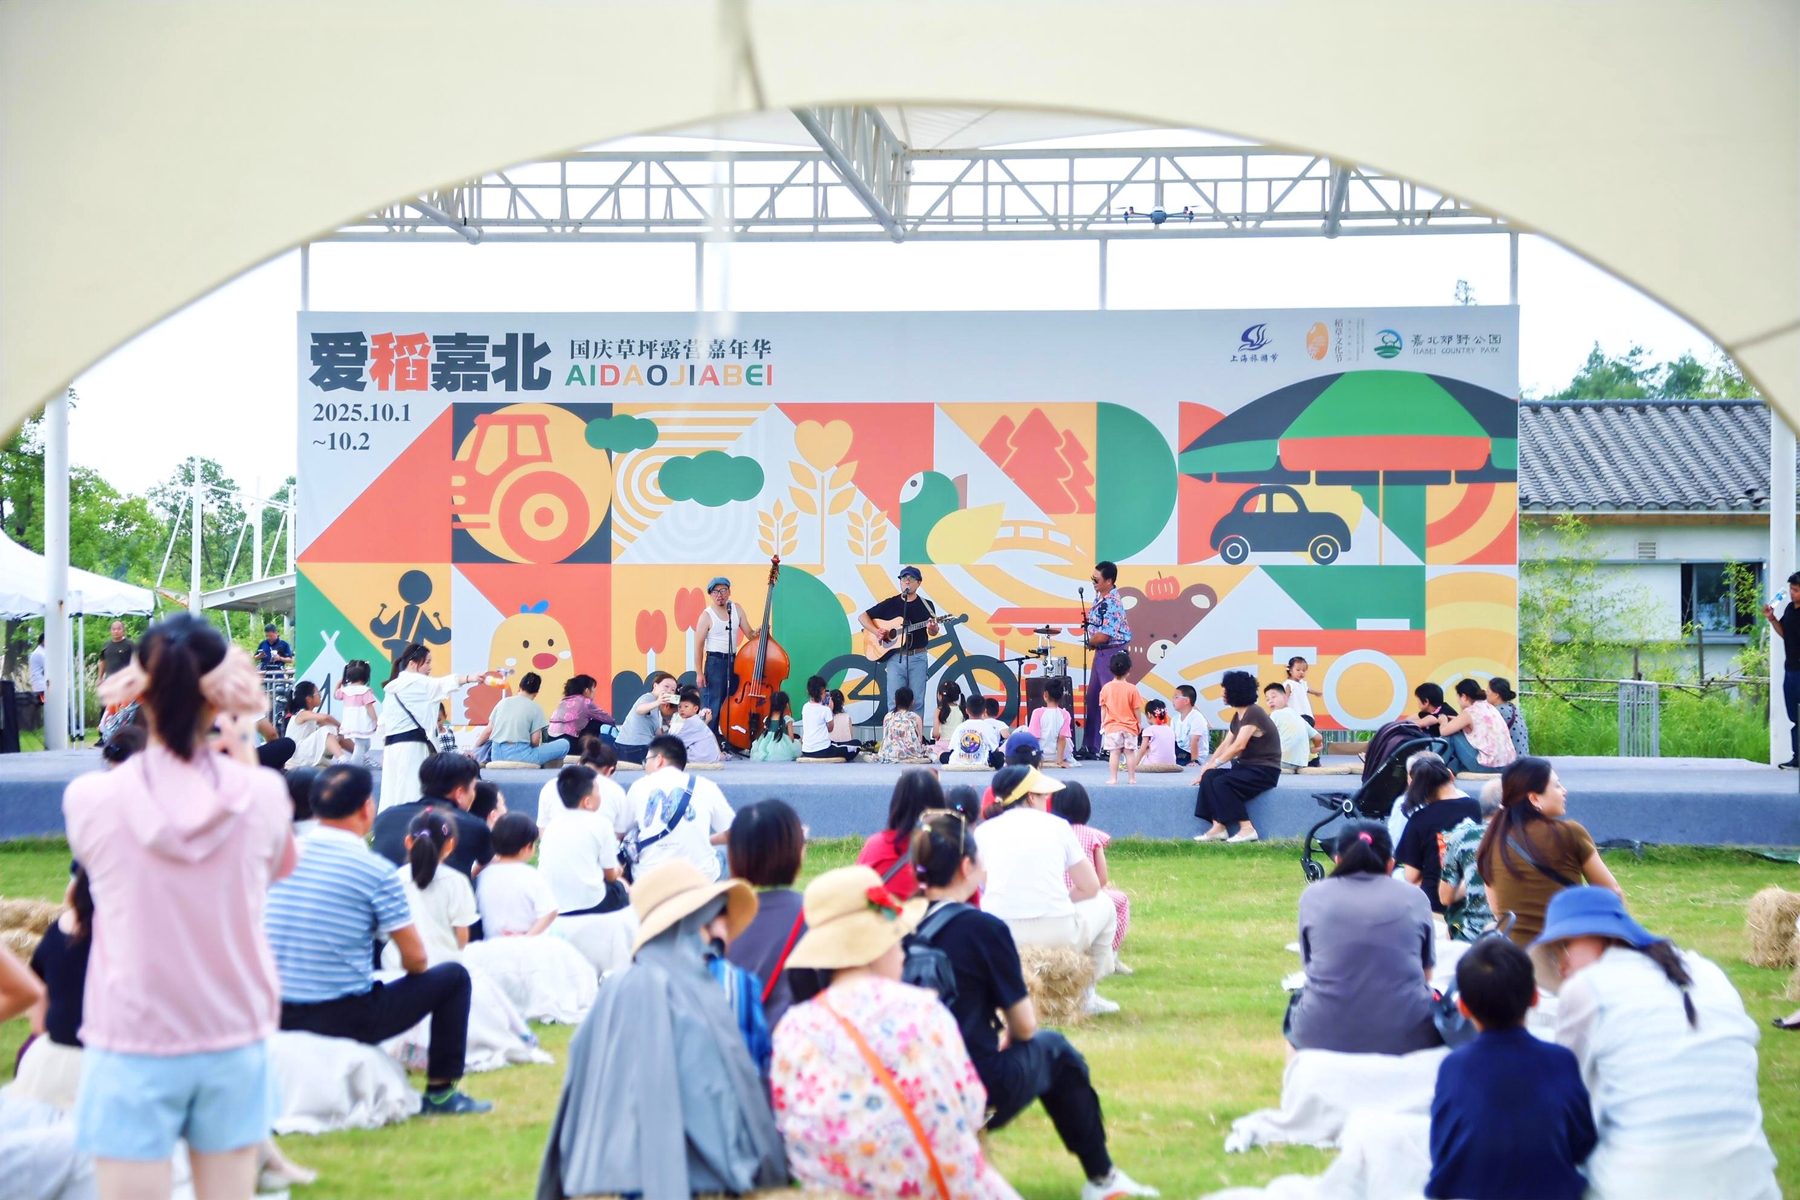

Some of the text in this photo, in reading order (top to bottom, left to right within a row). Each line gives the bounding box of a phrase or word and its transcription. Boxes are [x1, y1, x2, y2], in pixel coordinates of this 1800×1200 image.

[570, 338, 772, 360] 国庆草坪露营嘉年华
[1411, 334, 1502, 347] 嘉北郊野公园
[1480, 346, 1500, 354] PARK
[309, 331, 552, 392] 爱稻嘉北
[565, 364, 774, 387] AIDAOJIABEI
[312, 402, 412, 423] 2025.10.1
[312, 431, 371, 451] ~10.2
